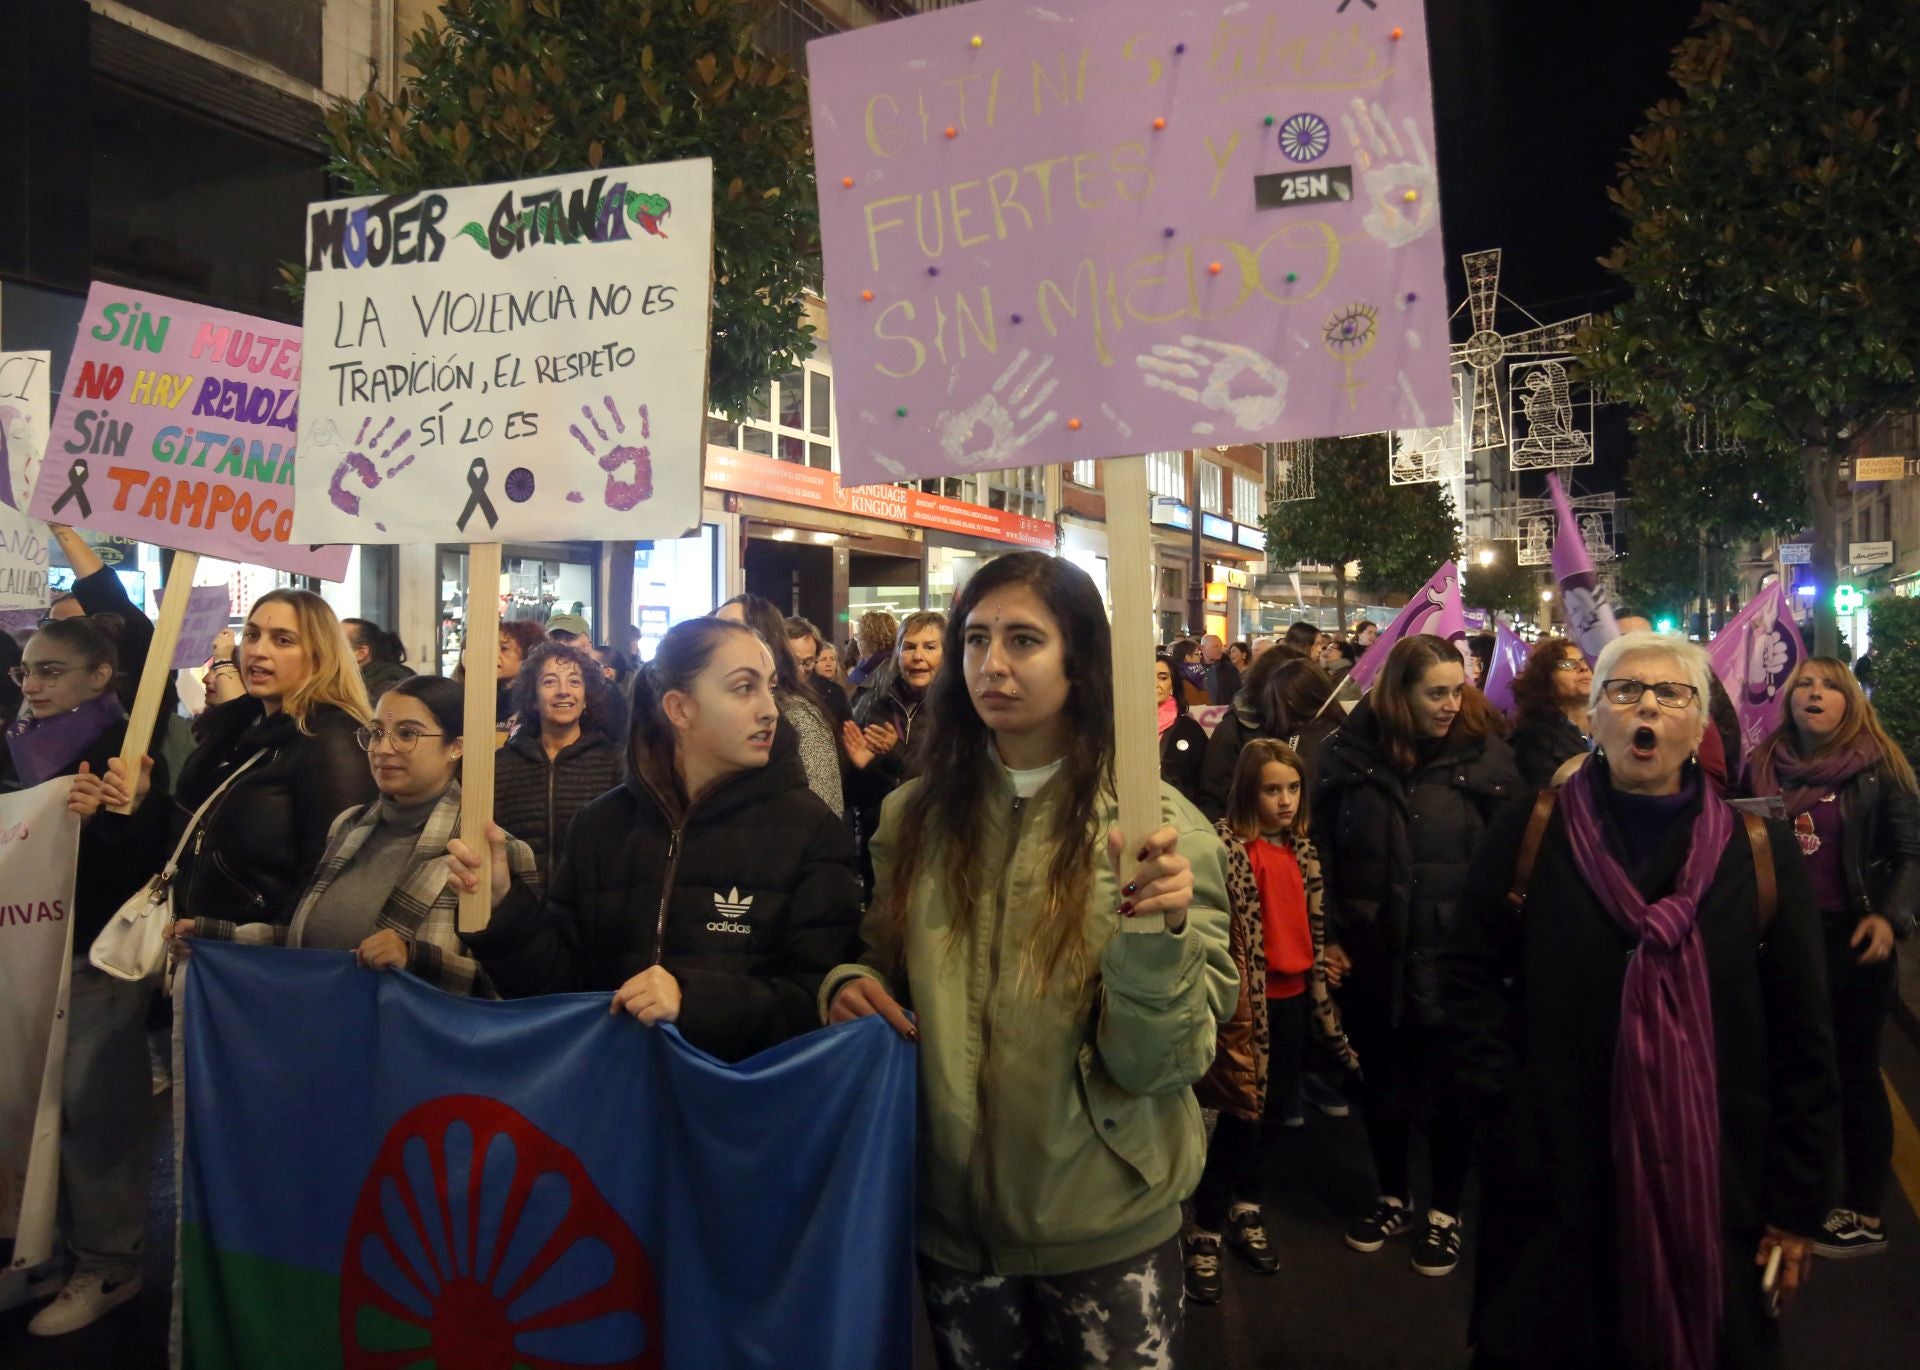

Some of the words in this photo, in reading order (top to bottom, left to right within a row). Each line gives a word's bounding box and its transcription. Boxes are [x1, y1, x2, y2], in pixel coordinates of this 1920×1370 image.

[863, 140, 1157, 272] FUERTES
[1202, 129, 1242, 198] Y
[1280, 173, 1328, 201] 25N
[308, 190, 449, 272] MUJER
[335, 297, 386, 349] LA
[413, 279, 576, 338] VIOLENCIA
[588, 283, 632, 321] NO
[641, 284, 679, 315] ES
[872, 287, 999, 379] SIN
[1036, 219, 1343, 367] MIEDO
[190, 321, 302, 381] MUJE
[494, 353, 526, 388] EL
[535, 342, 636, 384] RESPETO
[73, 361, 124, 401] NO
[129, 369, 194, 409] HAY
[420, 401, 454, 446] SÍ
[460, 416, 494, 445] LO
[504, 411, 539, 440] ES
[107, 466, 293, 543] TAMPOCO
[851, 496, 907, 520] KINGDOM
[0, 900, 64, 927] IVAS
[706, 921, 751, 934] adidas
